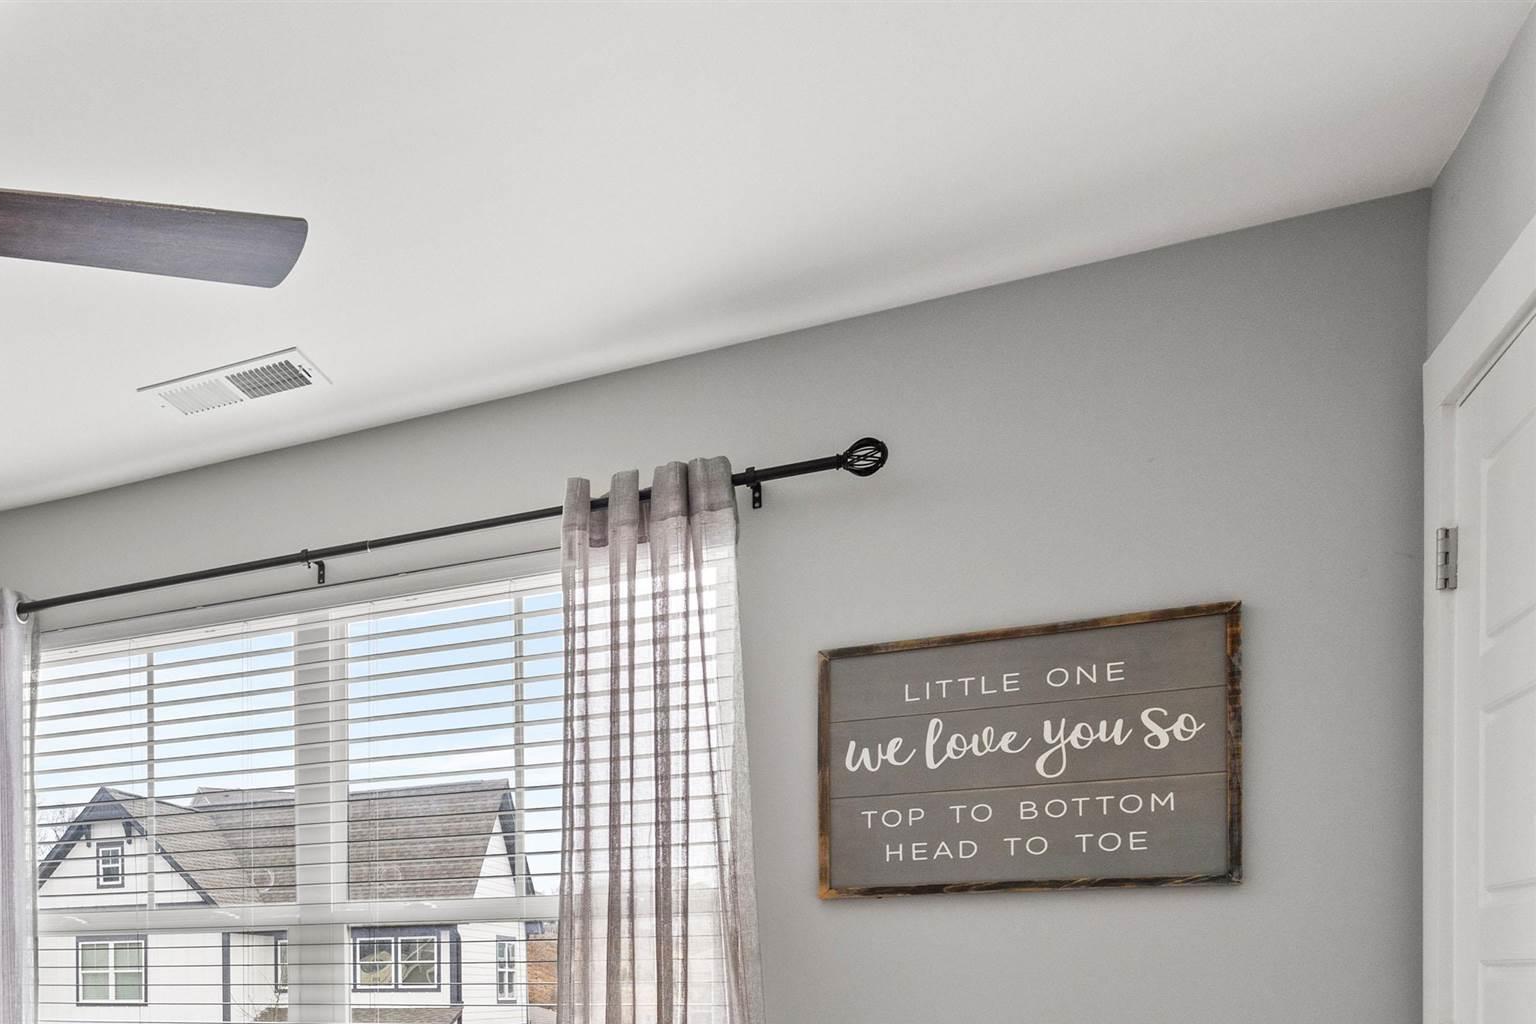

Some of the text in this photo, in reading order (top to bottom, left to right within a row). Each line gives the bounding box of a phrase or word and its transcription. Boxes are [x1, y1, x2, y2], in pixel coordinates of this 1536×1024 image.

[904, 661, 1125, 702] LITTLE ONE
[845, 735, 917, 772] we
[925, 717, 1032, 770] love
[1035, 717, 1133, 779] you
[861, 791, 1175, 829] TOP TO BOTTOM
[885, 831, 1149, 862] HEAD TO TOE
